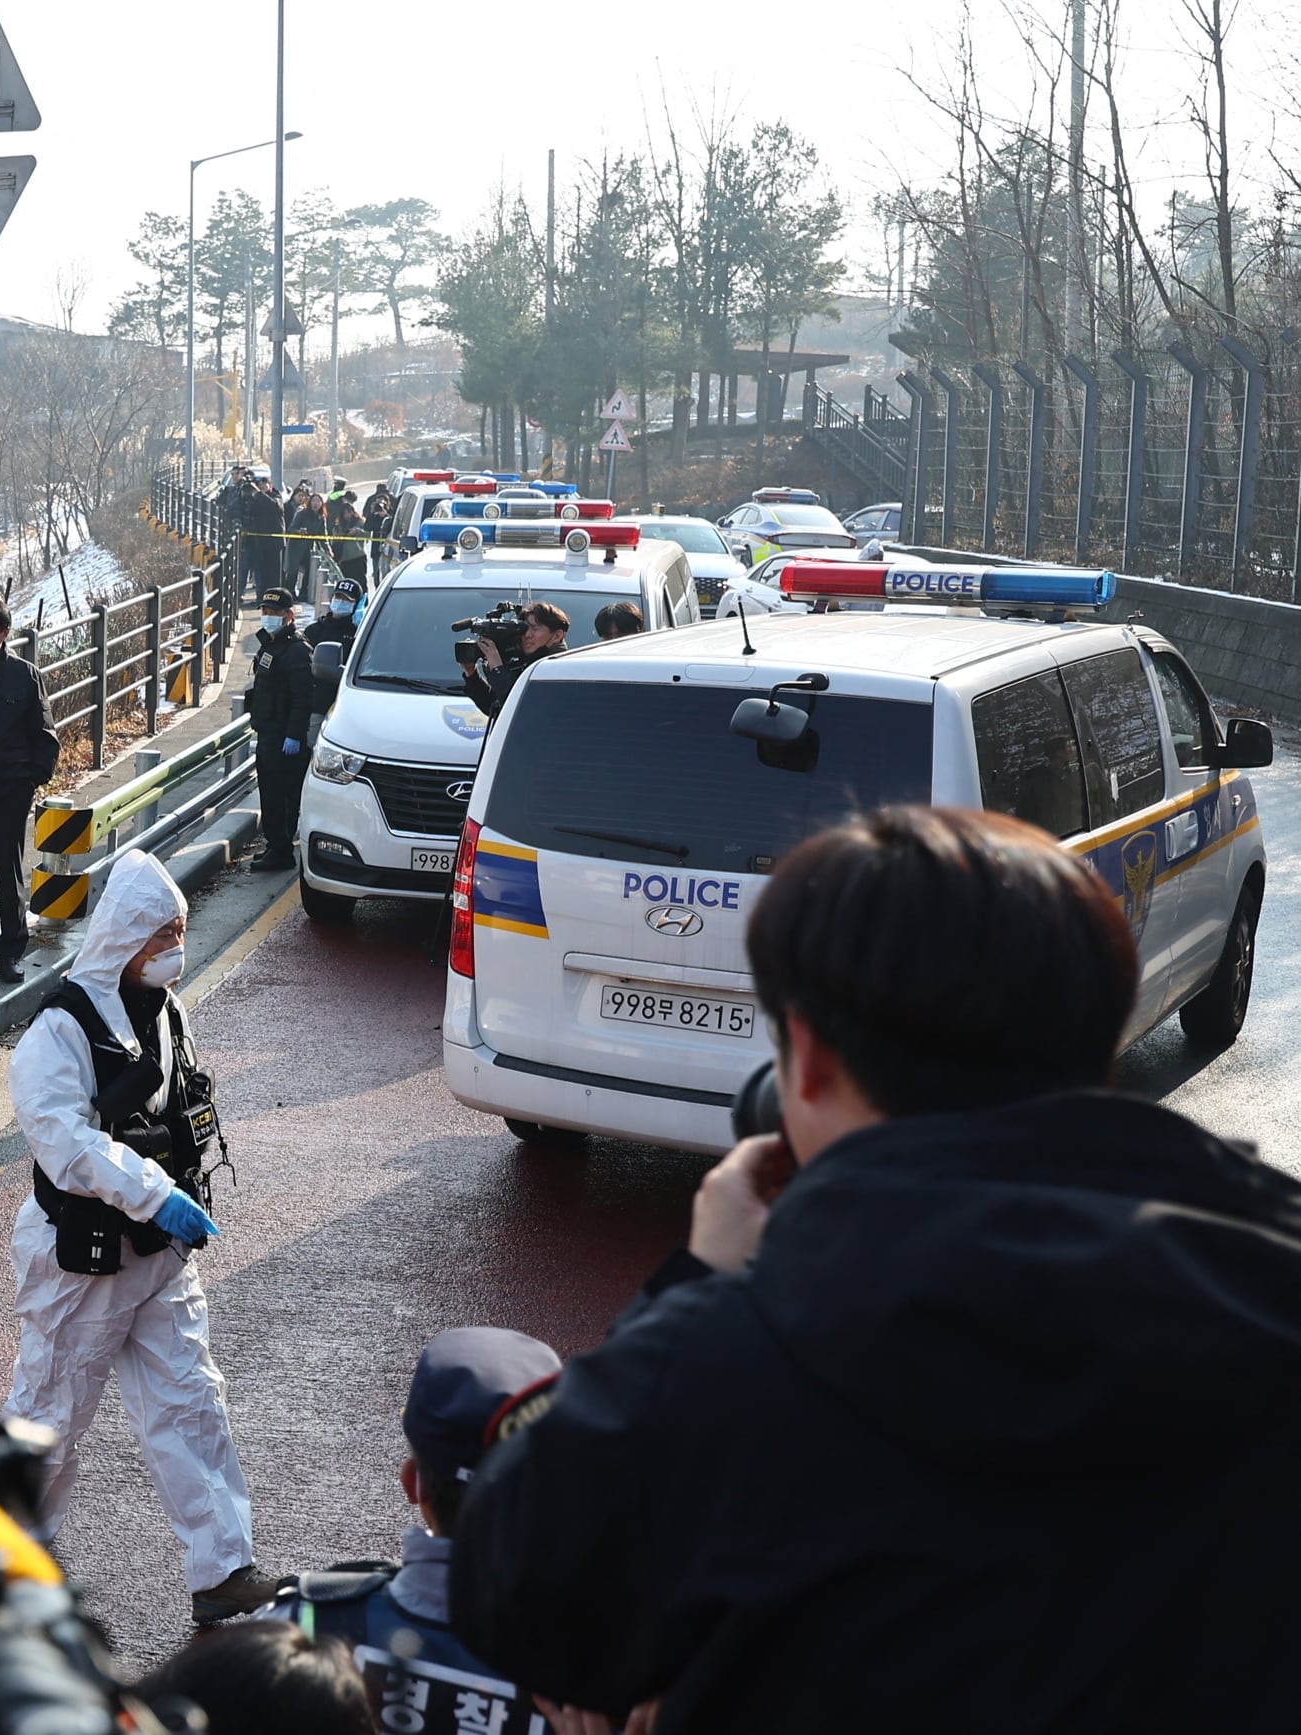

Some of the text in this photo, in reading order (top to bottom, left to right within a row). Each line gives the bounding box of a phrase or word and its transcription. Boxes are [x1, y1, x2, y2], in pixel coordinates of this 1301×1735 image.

[339, 582, 354, 592] CSI
[892, 572, 974, 593] POLICE
[418, 853, 456, 870] 998
[623, 872, 740, 910] POLICE
[611, 991, 744, 1032] 998무 8215
[192, 1111, 213, 1128] KCSI
